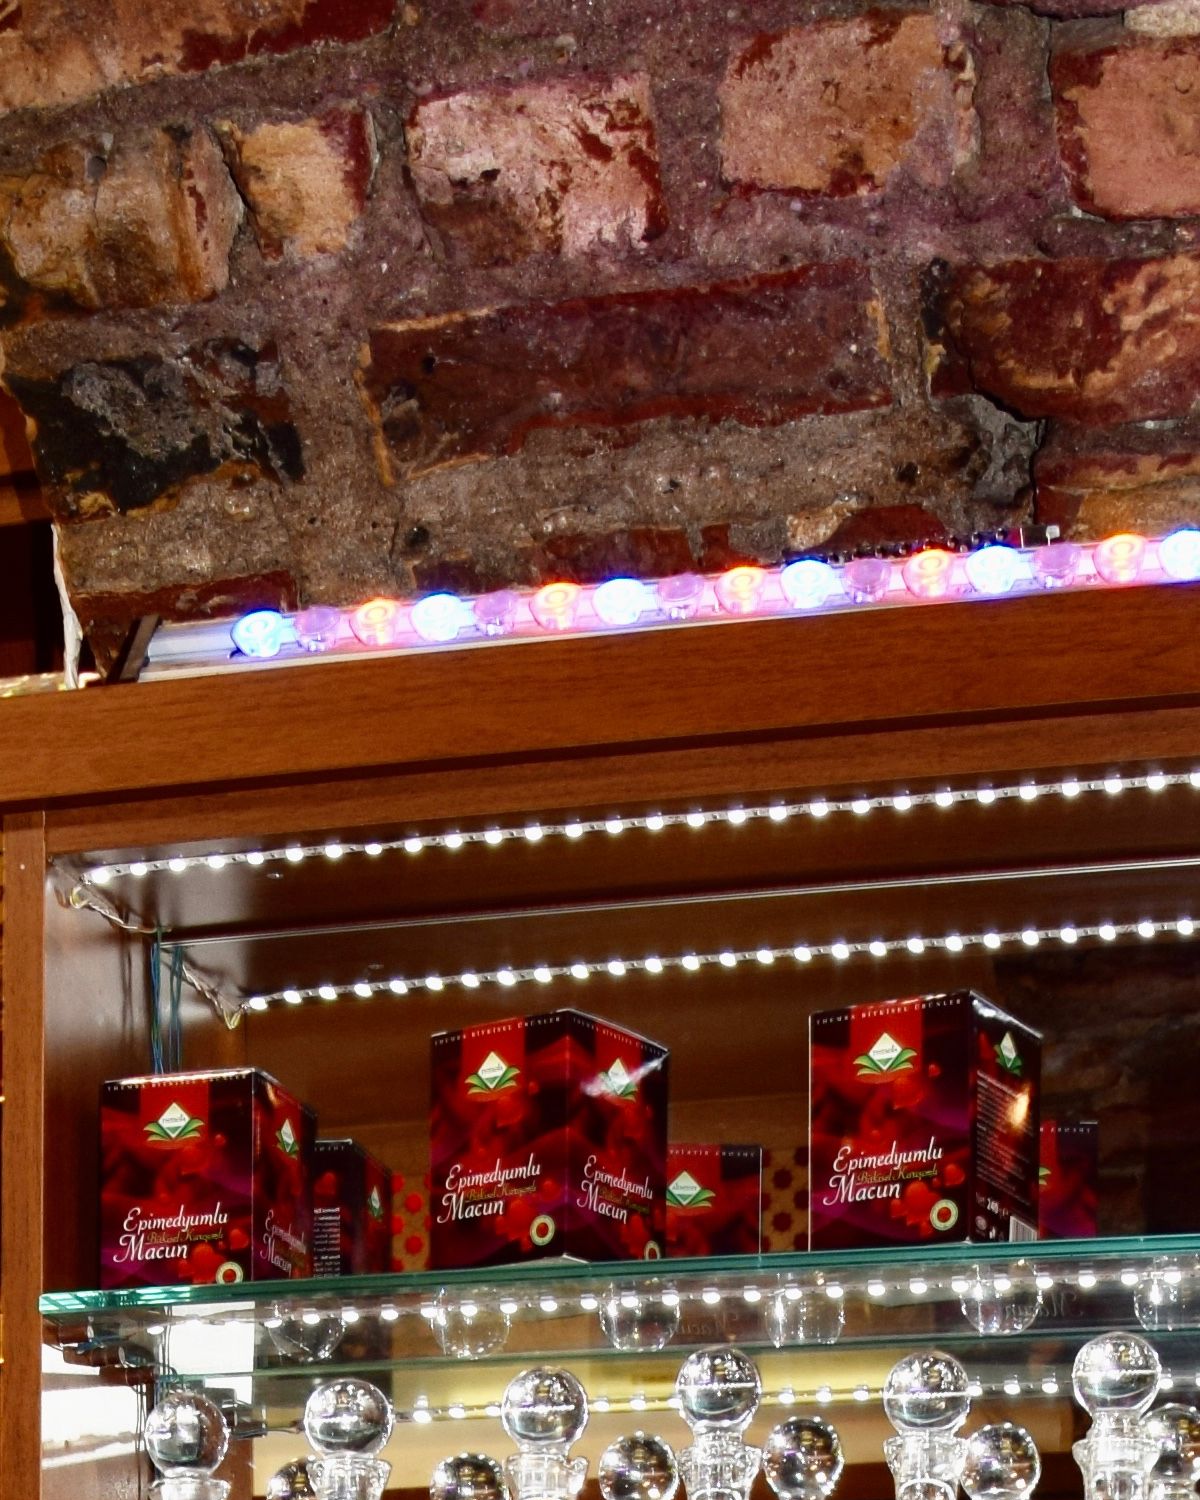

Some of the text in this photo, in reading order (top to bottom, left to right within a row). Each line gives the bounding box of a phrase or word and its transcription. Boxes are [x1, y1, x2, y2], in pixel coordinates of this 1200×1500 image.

[445, 1152, 541, 1192] Epimedyumlu
[832, 1136, 943, 1175] Epimedyumlu
[583, 1154, 653, 1200] Epimedyumlu
[822, 1172, 900, 1206] Macun
[123, 1202, 228, 1233] Epimedyumlu
[436, 1191, 504, 1223] Macun
[576, 1179, 628, 1224] Macun
[113, 1234, 188, 1263] Macun
[259, 1233, 292, 1279] Macun
